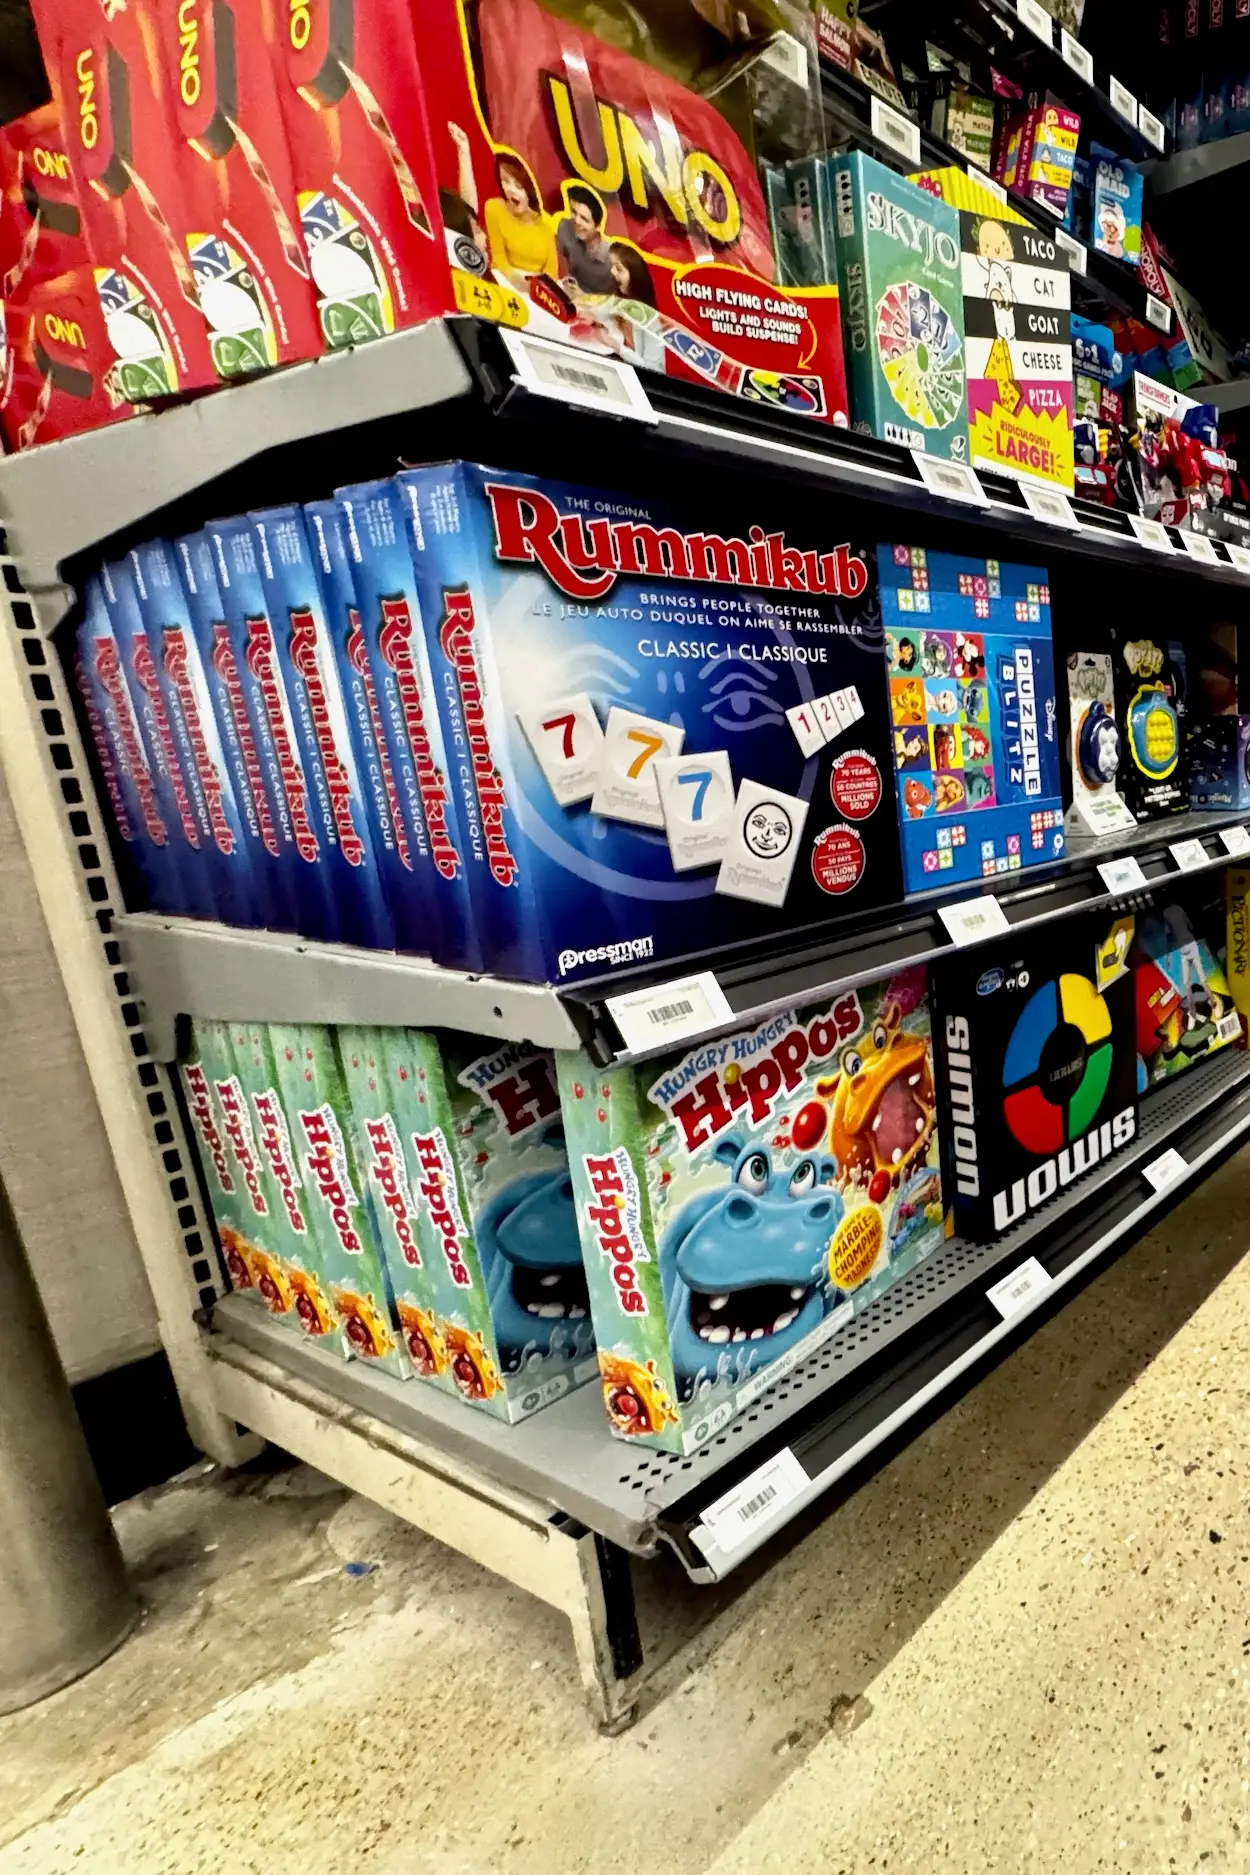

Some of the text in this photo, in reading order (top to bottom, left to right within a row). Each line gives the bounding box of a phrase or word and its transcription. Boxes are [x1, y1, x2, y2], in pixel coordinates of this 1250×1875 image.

[178, 0, 201, 105] UNO
[77, 48, 98, 149] UNO
[549, 77, 741, 243] UNO
[1056, 152, 1073, 166] TACO
[867, 191, 959, 270] SKYJO
[1023, 236, 1055, 261] TACO
[535, 285, 561, 316] UNO
[675, 281, 808, 320] HIGH FLYING CARDS!
[1034, 278, 1055, 299] CAT
[45, 313, 86, 350] UNO
[699, 306, 801, 334] LIGHTS AND SOUNDS
[712, 321, 798, 345] BUILD SUSPENSE!
[1028, 312, 1059, 336] GOAT
[1022, 351, 1063, 372] CHEESE
[1029, 388, 1064, 408] PIZZA
[1000, 419, 1051, 447] RIDICULOUSLY
[995, 433, 1057, 474] LARGE!
[564, 496, 652, 520] THE ORIGINAL
[484, 481, 869, 599] Rummikub
[532, 603, 864, 635] LE JEU AUTO DUQUEL ON AIME SE RASSEMBLER
[640, 594, 820, 619] BRINGS PEOPLE TOGETHER
[638, 640, 828, 664] CLASSIC CLASSIQUE
[797, 712, 811, 733] 1
[820, 702, 831, 722] 2
[837, 696, 845, 711] 3
[1001, 663, 1023, 785] BLITZ
[1018, 650, 1040, 794] PUZZLE
[163, 630, 235, 855] Rummikub
[246, 620, 320, 863] Rummikub
[290, 612, 366, 866] Rummikub
[379, 599, 461, 880] Rummikub
[440, 591, 519, 887] Rummikub
[542, 713, 577, 759] 7
[626, 730, 664, 780] 7
[217, 687, 259, 837] CLASSIC CLASSIQUE
[251, 686, 293, 842] CLASSIC CLASSIQUE
[294, 682, 336, 845] CLASSIC CLASSIQUE
[352, 680, 394, 850] CLASSIC CLASSIQUE
[384, 677, 428, 856] CLASSIC CLASSIQUE
[444, 672, 484, 861] CLASSIC CLASSIQUE
[832, 748, 877, 770] Rummikub
[841, 767, 871, 777] 70 YEARS
[677, 771, 713, 821] 7
[840, 792, 874, 803] MILLIONS
[845, 781, 878, 791] COUNTRIES
[850, 800, 869, 811] SOLD
[814, 822, 861, 847] Rummikub
[838, 841, 851, 850] ANS
[822, 864, 857, 878] MILLIONS
[836, 855, 852, 864] PAYS
[826, 874, 857, 886] VENDUS
[1230, 895, 1246, 978] PICTIONARY
[610, 949, 653, 965] SINCE 1922
[654, 1014, 795, 1102] HUNGRY HUNGRY
[616, 1151, 637, 1206] HUNGRY
[834, 1222, 882, 1278] CHOMPING
